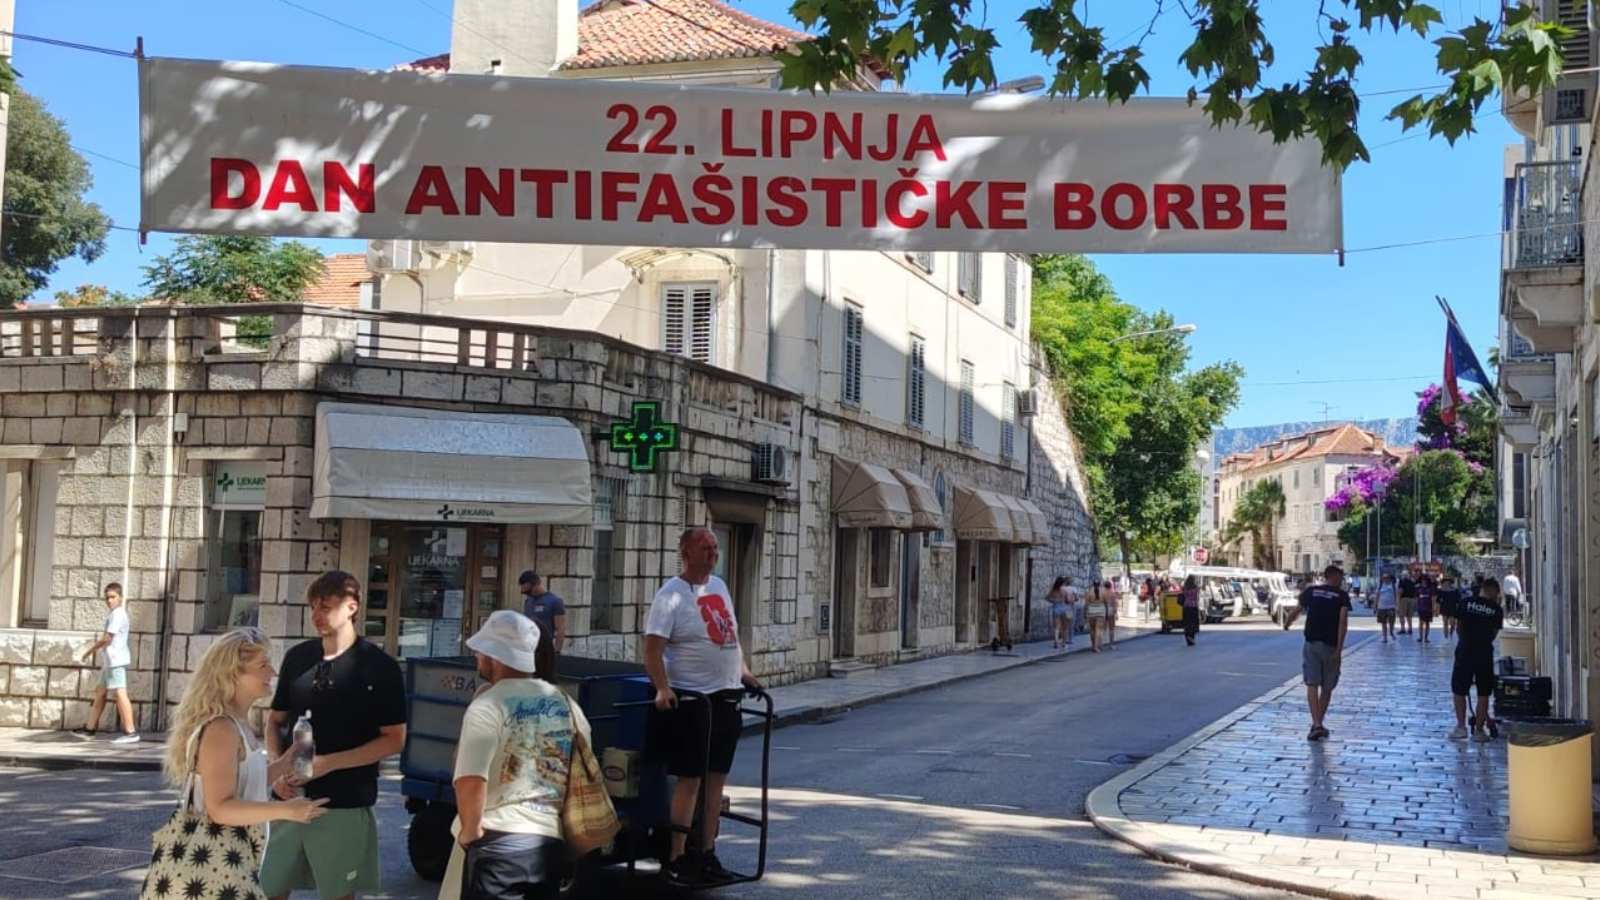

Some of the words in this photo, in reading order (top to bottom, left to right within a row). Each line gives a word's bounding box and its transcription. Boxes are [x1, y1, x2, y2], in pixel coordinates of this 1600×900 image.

[606, 103, 695, 155] 22.
[720, 109, 948, 162] LIPNJA
[210, 158, 376, 213] DAN
[405, 163, 1027, 231] ANTIFAŠISTIČKE
[1053, 183, 1287, 231] BORBE
[456, 508, 496, 517] LJEKARNA
[1467, 601, 1496, 615] Haier
